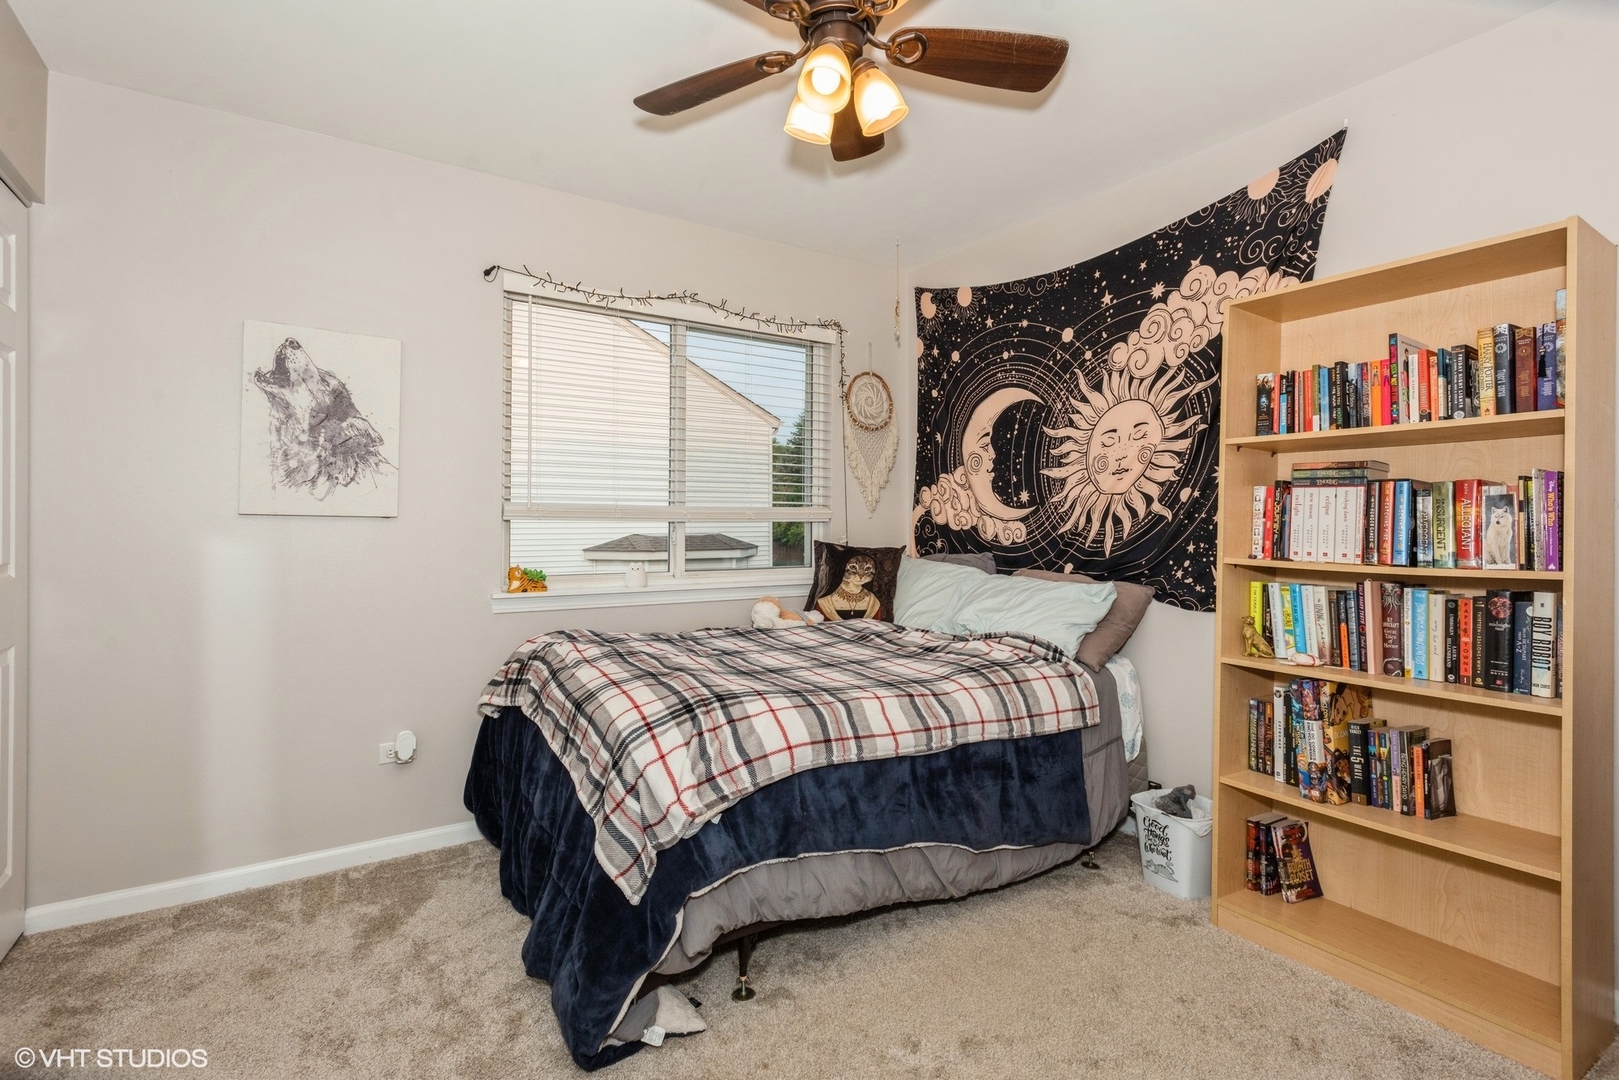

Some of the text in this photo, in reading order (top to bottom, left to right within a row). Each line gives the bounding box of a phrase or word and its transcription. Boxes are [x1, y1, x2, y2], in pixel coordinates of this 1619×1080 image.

[1483, 343, 1493, 391] HARRY POTTER
[1293, 495, 1302, 516] twilight
[1321, 496, 1331, 515] eclipse
[1420, 511, 1428, 555] DIVERGENT
[1436, 499, 1446, 550] INSURGENT
[1461, 498, 1471, 552] ALLEGIANT
[1315, 604, 1326, 649] LEAVING Season
[1489, 621, 1511, 629] midnight
[1532, 617, 1552, 671] BOY ROBOT
[1353, 746, 1361, 755] THE
[1354, 764, 1362, 780] WAVE
[1143, 816, 1169, 837] Good
[1287, 858, 1311, 874] FOURTH
[1289, 870, 1314, 885] CLOSET
